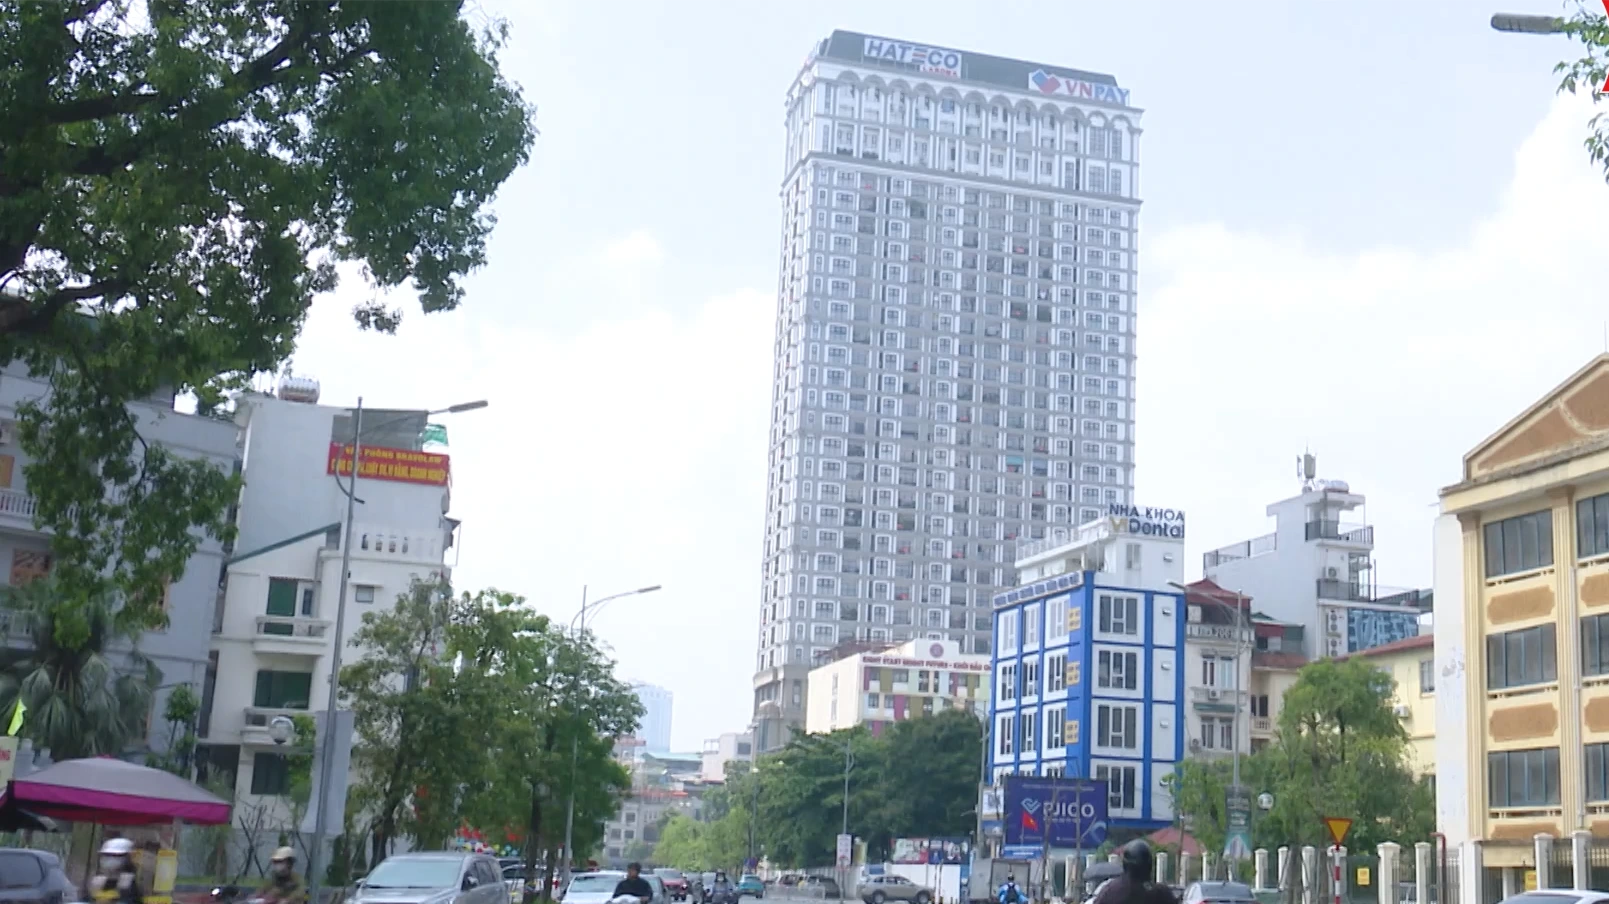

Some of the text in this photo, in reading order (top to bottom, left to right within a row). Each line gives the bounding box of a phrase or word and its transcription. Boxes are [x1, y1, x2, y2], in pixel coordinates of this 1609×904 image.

[866, 40, 959, 69] HATECO
[1065, 80, 1130, 105] VNPAY
[1109, 504, 1185, 521] NHA KHOA
